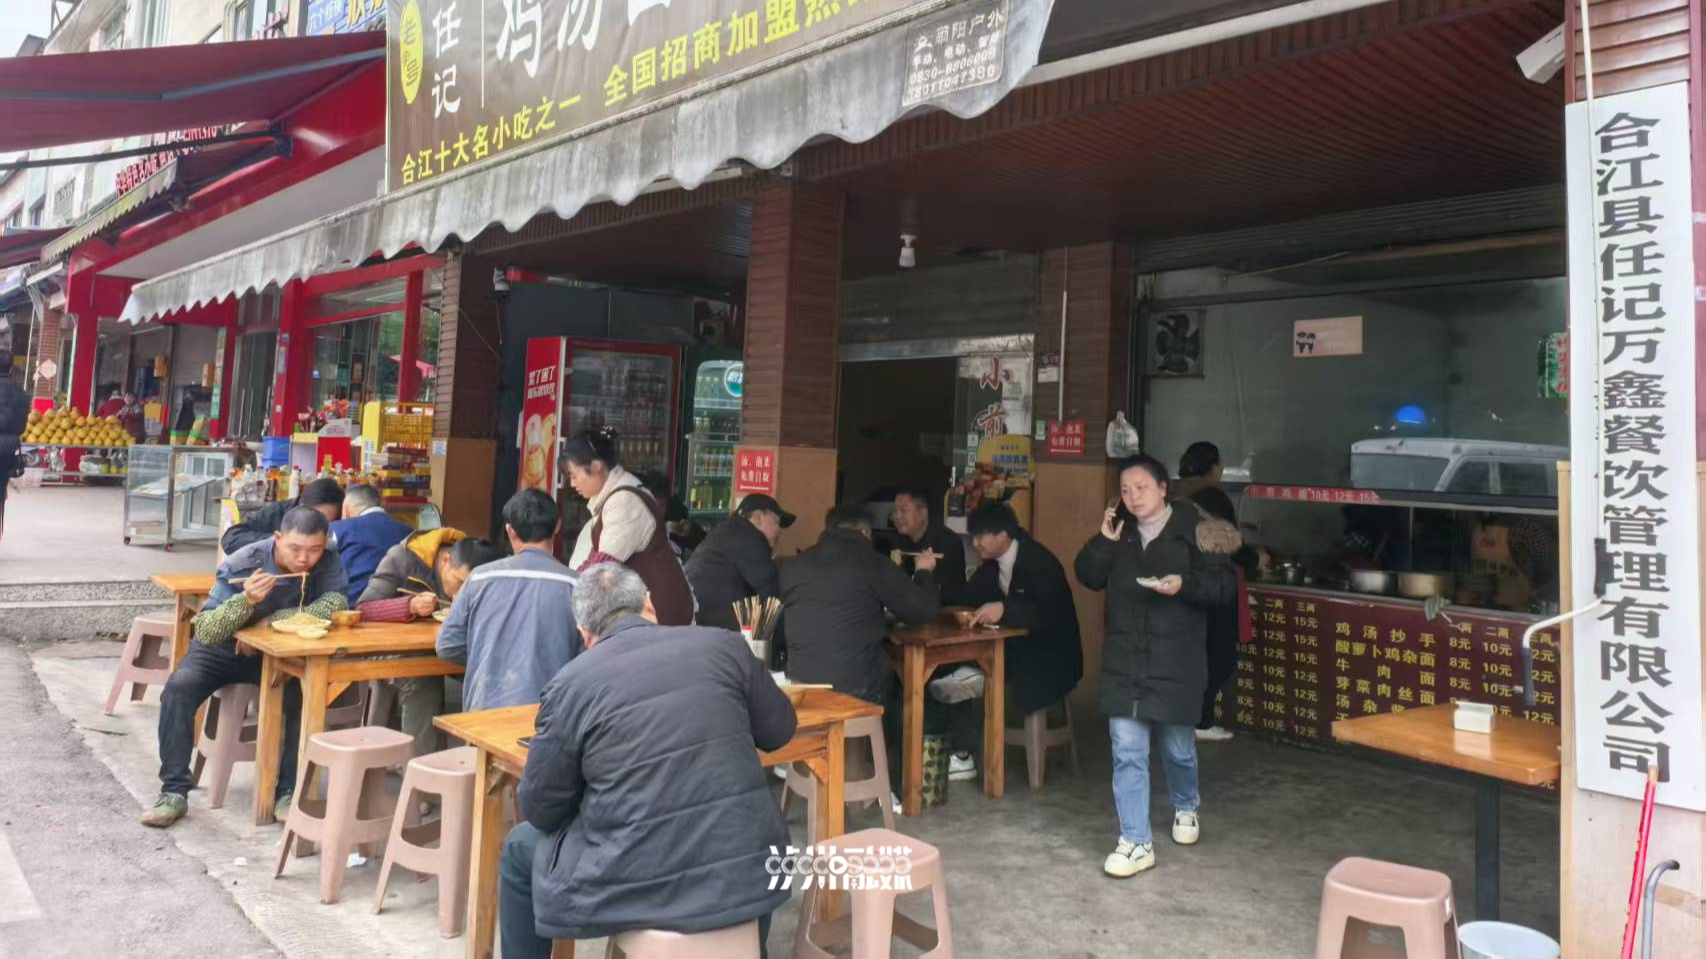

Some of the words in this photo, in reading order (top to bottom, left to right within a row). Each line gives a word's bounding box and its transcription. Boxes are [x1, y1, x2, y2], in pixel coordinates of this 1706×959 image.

[432, 4, 462, 118] 任记
[603, 0, 867, 106] 全国招商加盟热
[402, 95, 581, 185] 合江十大名小吃之一
[1595, 112, 1676, 782] 合江县任记万鑫餐饮管理有限公司
[1263, 612, 1286, 625] 12元
[1294, 616, 1318, 629] 15元
[1263, 630, 1286, 643] 12元
[1294, 634, 1318, 647] 15元
[1485, 626, 1509, 639] 二两
[1263, 647, 1286, 660] 12元
[1294, 652, 1318, 665] 15元
[1449, 637, 1472, 650] 8元
[1482, 642, 1512, 656] 10元
[1531, 649, 1555, 663] 2元
[1336, 640, 1436, 667] 酸萝卜鸡杂面
[1449, 657, 1471, 670] 8元
[1482, 662, 1512, 677] 10元
[1531, 670, 1555, 684] 2元
[1263, 665, 1286, 678] 10元
[1294, 670, 1318, 683] 12元
[1336, 657, 1436, 686] 牛肉面
[1449, 677, 1472, 690] 8元
[1482, 683, 1512, 697] 10元
[1533, 692, 1555, 705] 2元
[1263, 682, 1286, 695] 10元
[1294, 688, 1318, 701] 12元
[1263, 701, 1286, 714] 10元
[1294, 706, 1318, 720] 12元
[1523, 710, 1555, 725] 12元
